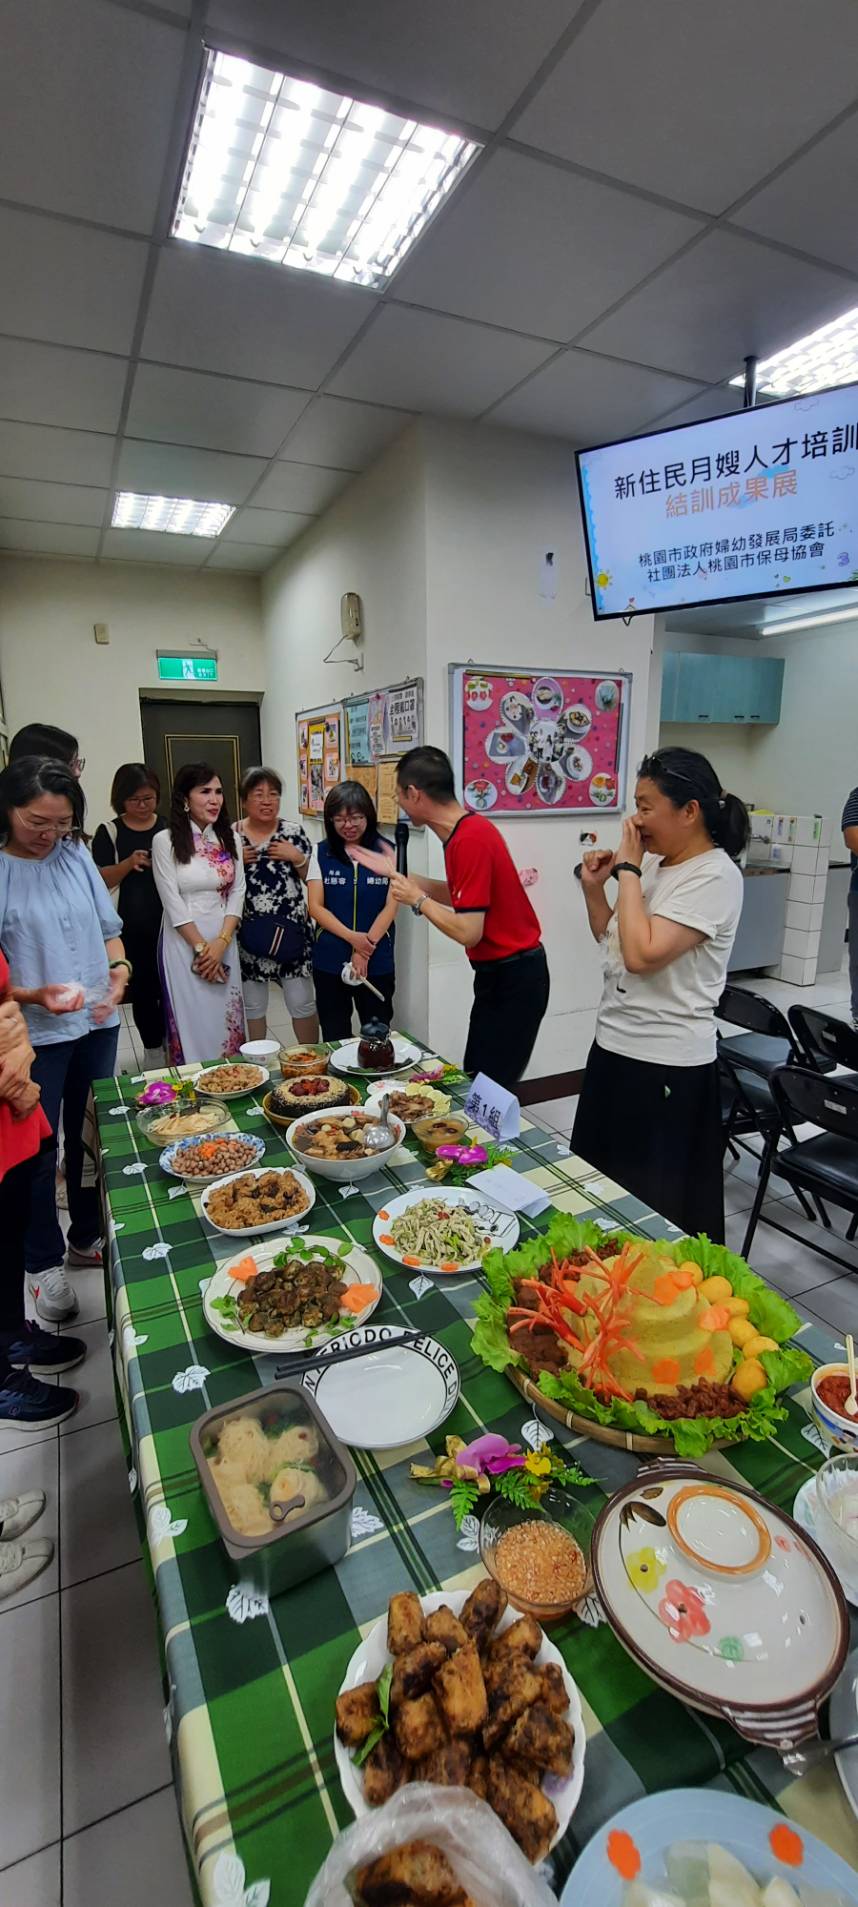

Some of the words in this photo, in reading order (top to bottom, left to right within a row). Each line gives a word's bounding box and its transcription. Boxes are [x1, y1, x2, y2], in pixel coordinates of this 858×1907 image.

[614, 422, 858, 500] 新住民月嫂人才培訓
[665, 470, 798, 519] 結訓成果展
[639, 521, 835, 568] 桃園市政府婦幼發展局委託
[647, 541, 825, 583] 社團法人桃園市保母協會
